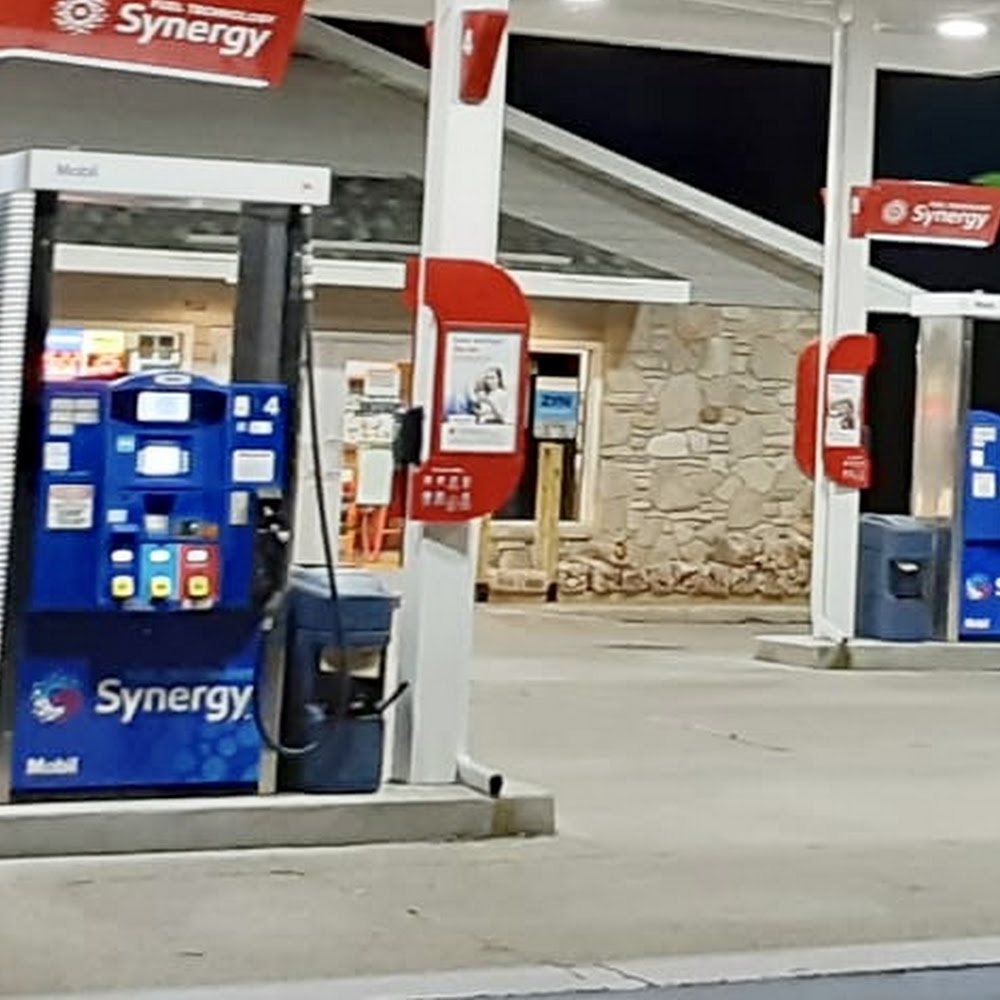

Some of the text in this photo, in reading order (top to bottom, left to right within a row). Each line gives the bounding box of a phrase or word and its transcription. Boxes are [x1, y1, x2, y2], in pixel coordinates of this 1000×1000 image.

[116, 2, 272, 57] Synergy
[910, 204, 991, 232] Synergy
[262, 396, 280, 416] 4
[95, 678, 254, 723] Synergy
